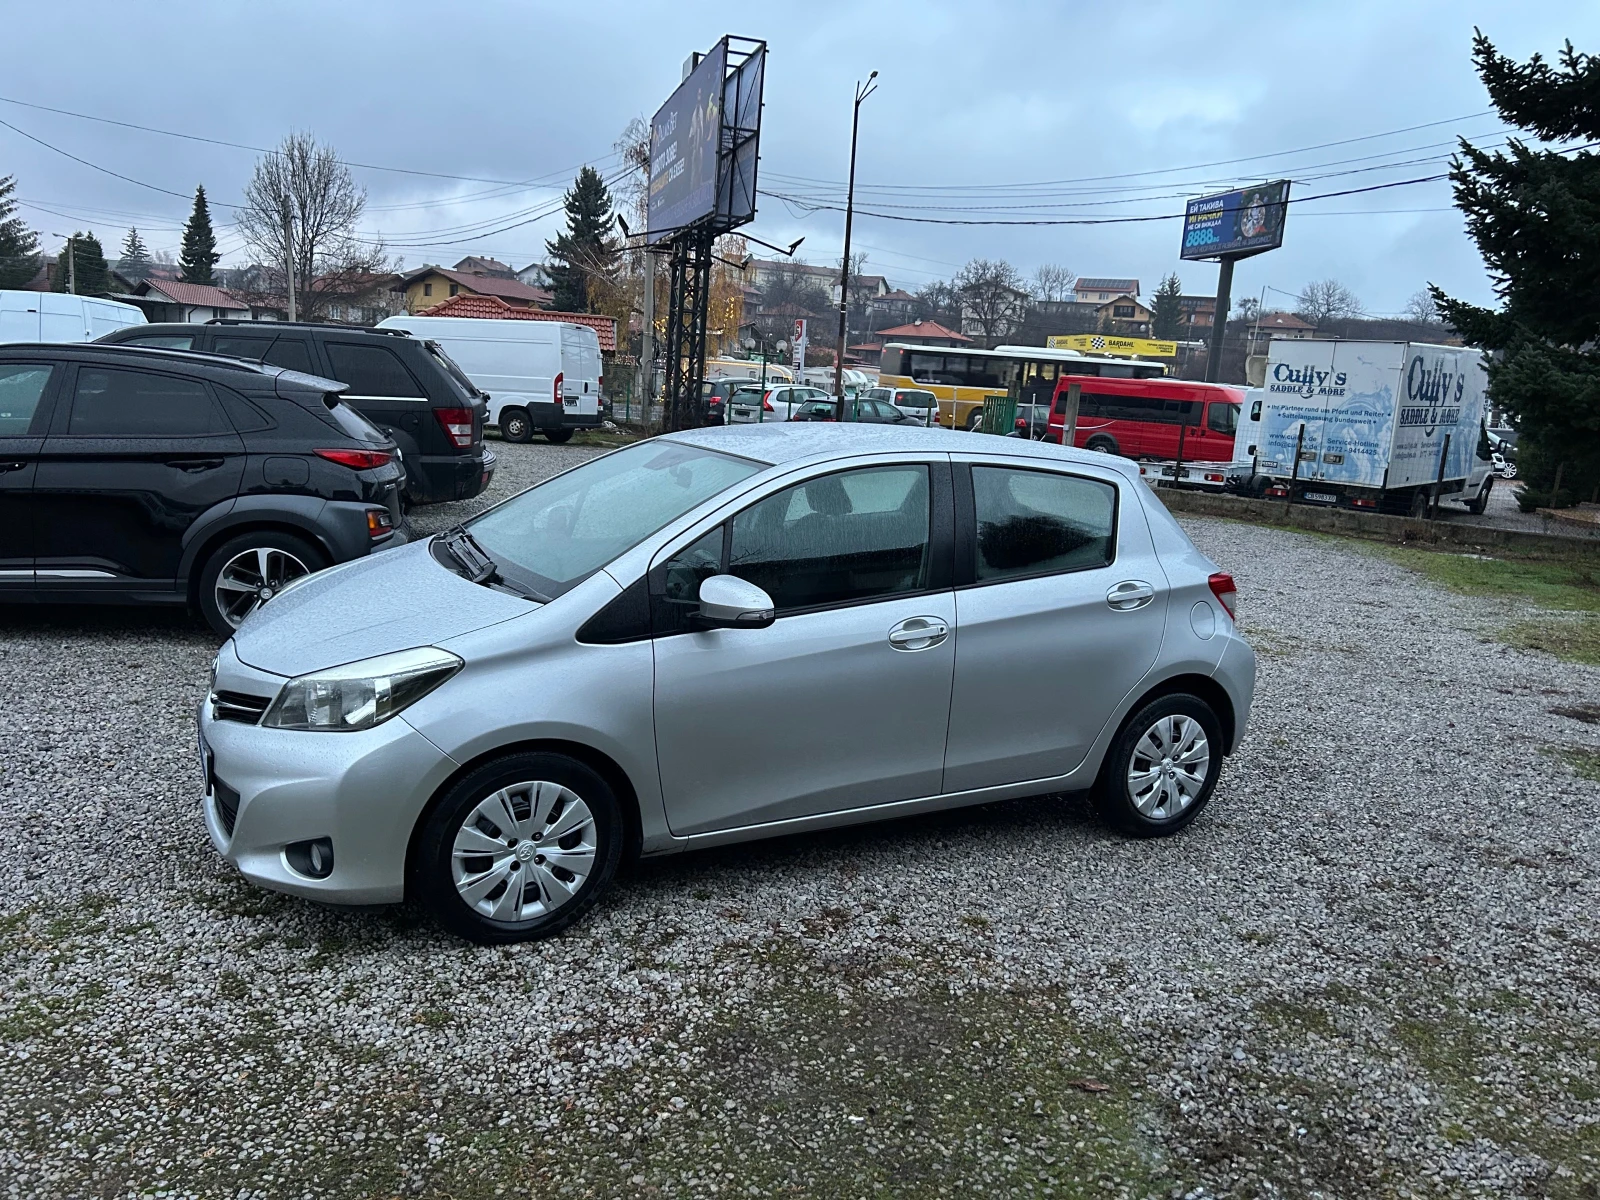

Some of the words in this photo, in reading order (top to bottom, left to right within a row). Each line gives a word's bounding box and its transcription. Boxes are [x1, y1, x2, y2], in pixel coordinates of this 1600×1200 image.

[1190, 203, 1198, 213] ЕЙ
[1199, 199, 1223, 211] ТАКИВА
[1201, 220, 1221, 228] ВИЖДАЛ
[1108, 339, 1135, 349] BARDAHL
[1273, 363, 1347, 387] Cully's
[1407, 355, 1465, 406] Cully's
[1270, 384, 1304, 393] SADDLE
[1306, 386, 1315, 394] &
[1318, 387, 1346, 396] MORE
[1281, 404, 1303, 412] Partner
[1364, 410, 1384, 418] Reiter
[1400, 408, 1429, 425] SADDLE
[1430, 407, 1438, 424] &
[1439, 408, 1460, 424] MORE
[1282, 413, 1333, 423] Sattelanpassung
[1335, 417, 1372, 425] bundesweit
[1327, 438, 1379, 448] Service-Hotline
[1327, 445, 1343, 453] 0172
[1348, 447, 1378, 456] 9414425
